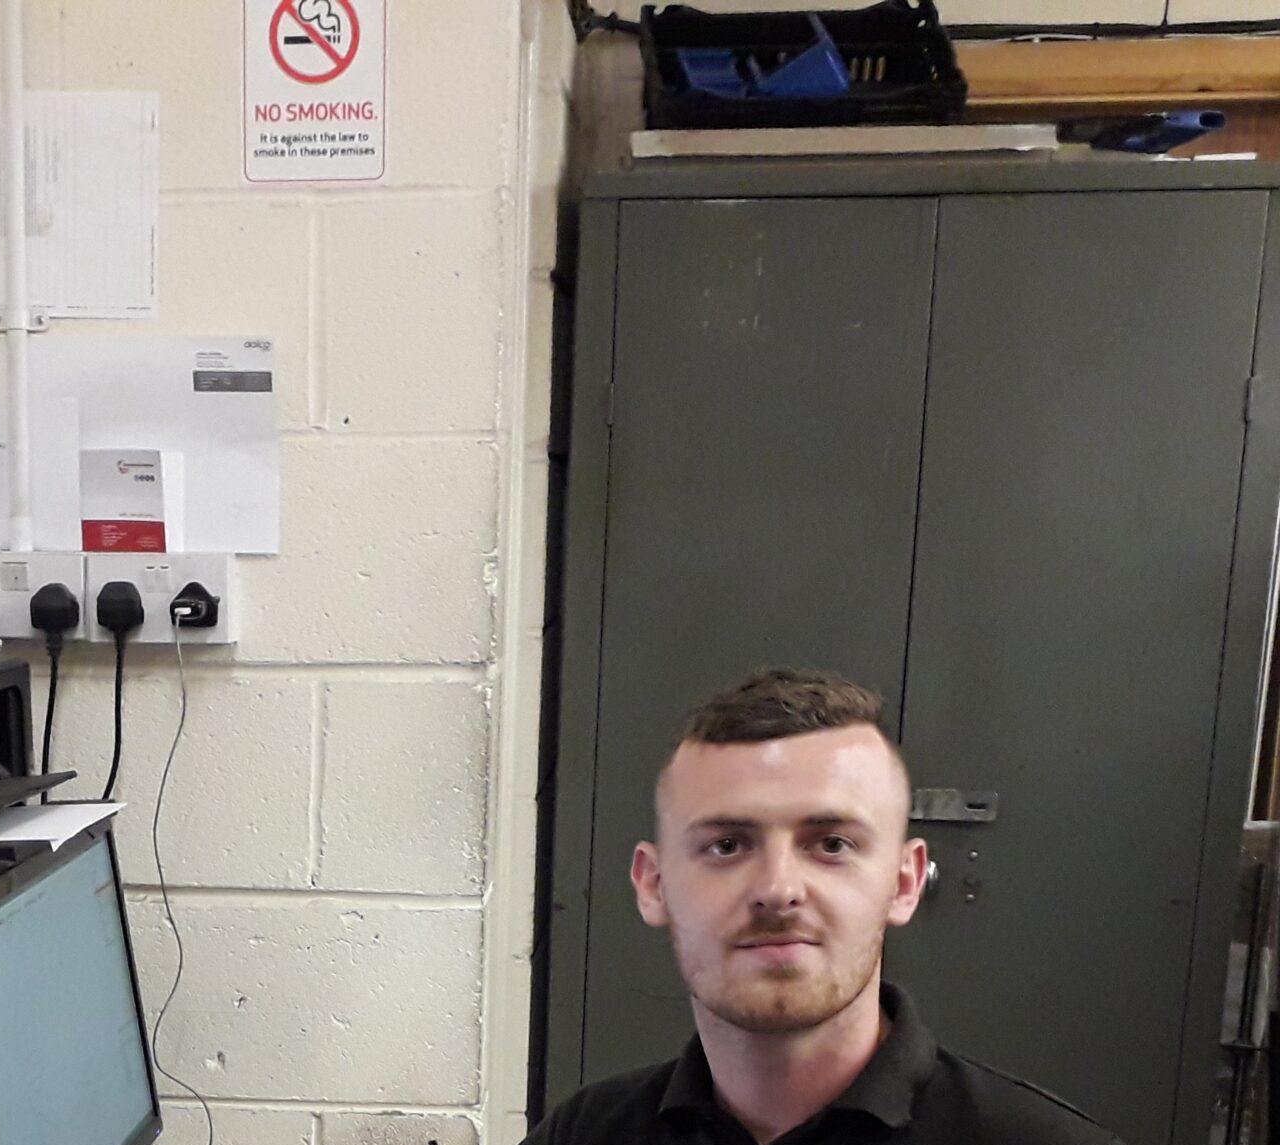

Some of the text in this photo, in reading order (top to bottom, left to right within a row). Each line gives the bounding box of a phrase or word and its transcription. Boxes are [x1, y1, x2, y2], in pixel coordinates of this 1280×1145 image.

[255, 102, 378, 122] NO SMOKING.
[260, 132, 368, 147] It is against the law to
[254, 147, 375, 159] smoke in these premises
